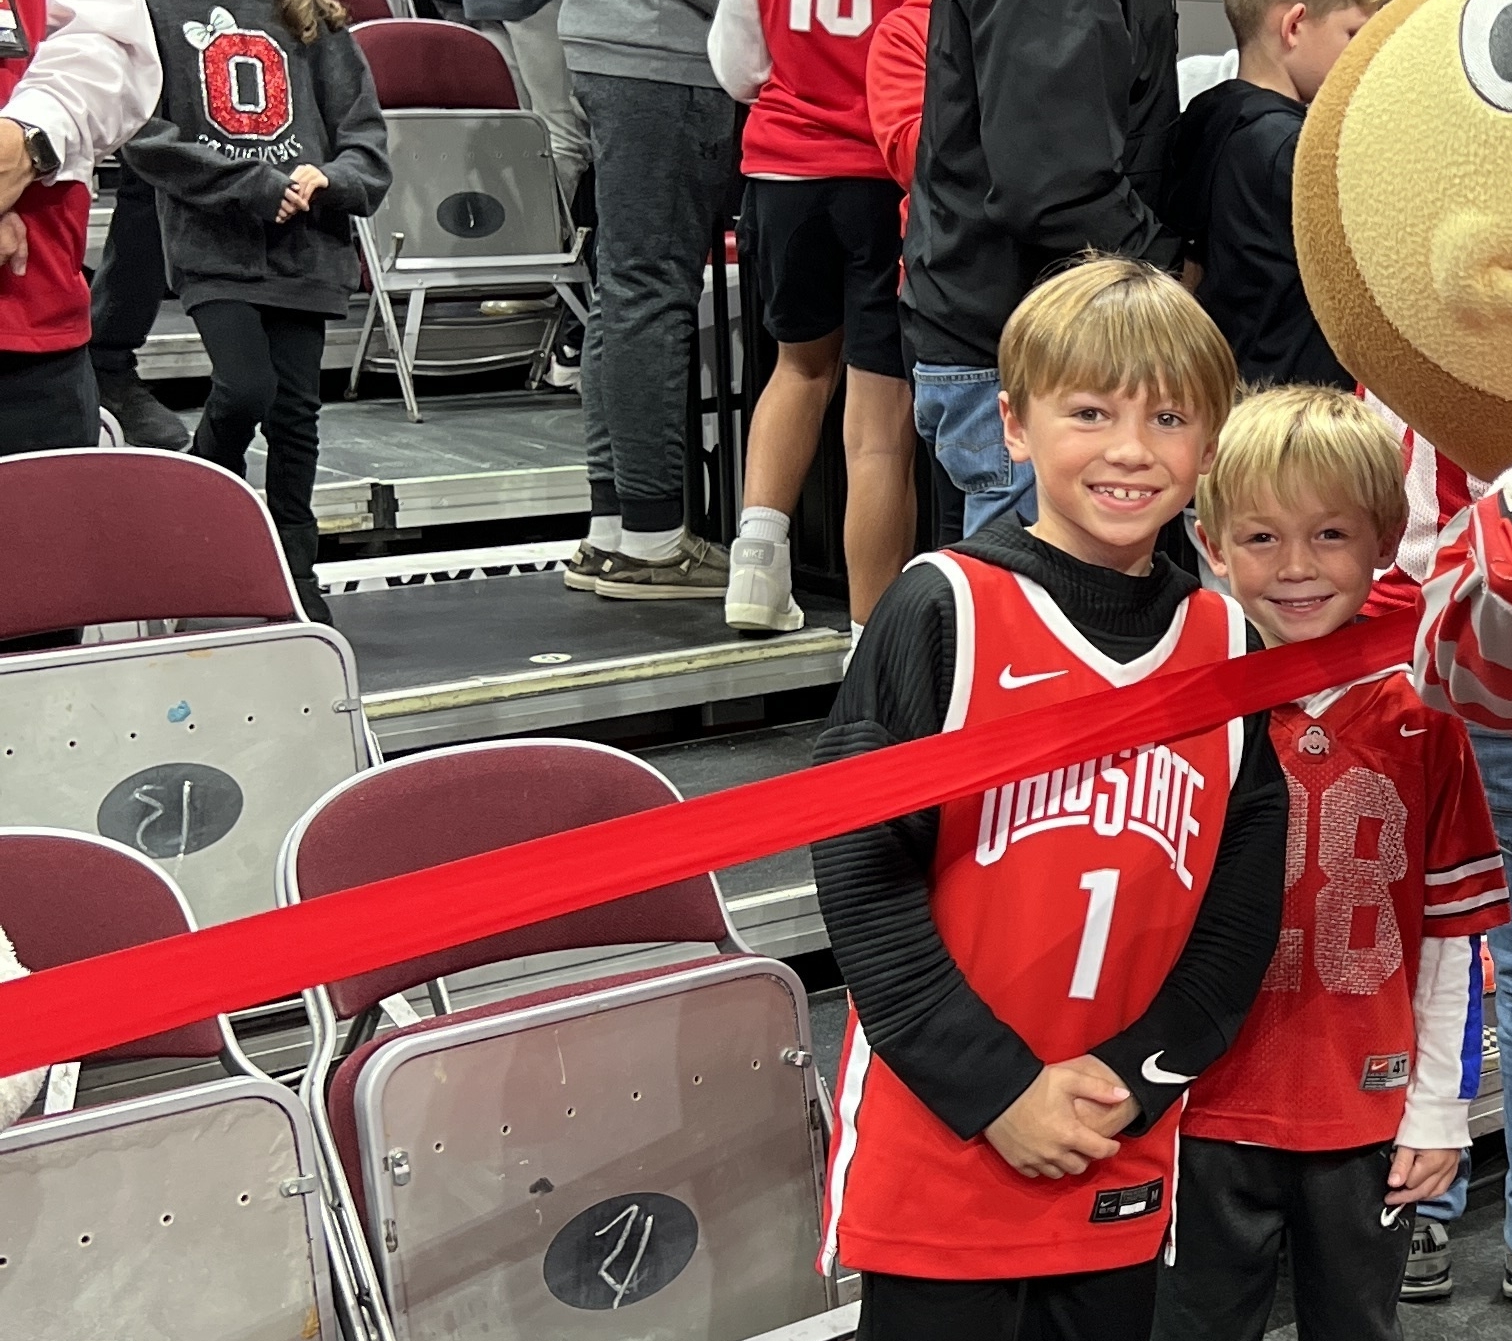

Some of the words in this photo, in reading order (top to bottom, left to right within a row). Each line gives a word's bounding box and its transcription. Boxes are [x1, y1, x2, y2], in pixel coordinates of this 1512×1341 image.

[198, 27, 293, 141] O
[1068, 868, 1120, 1000] 1
[1392, 1058, 1408, 1074] 4T
